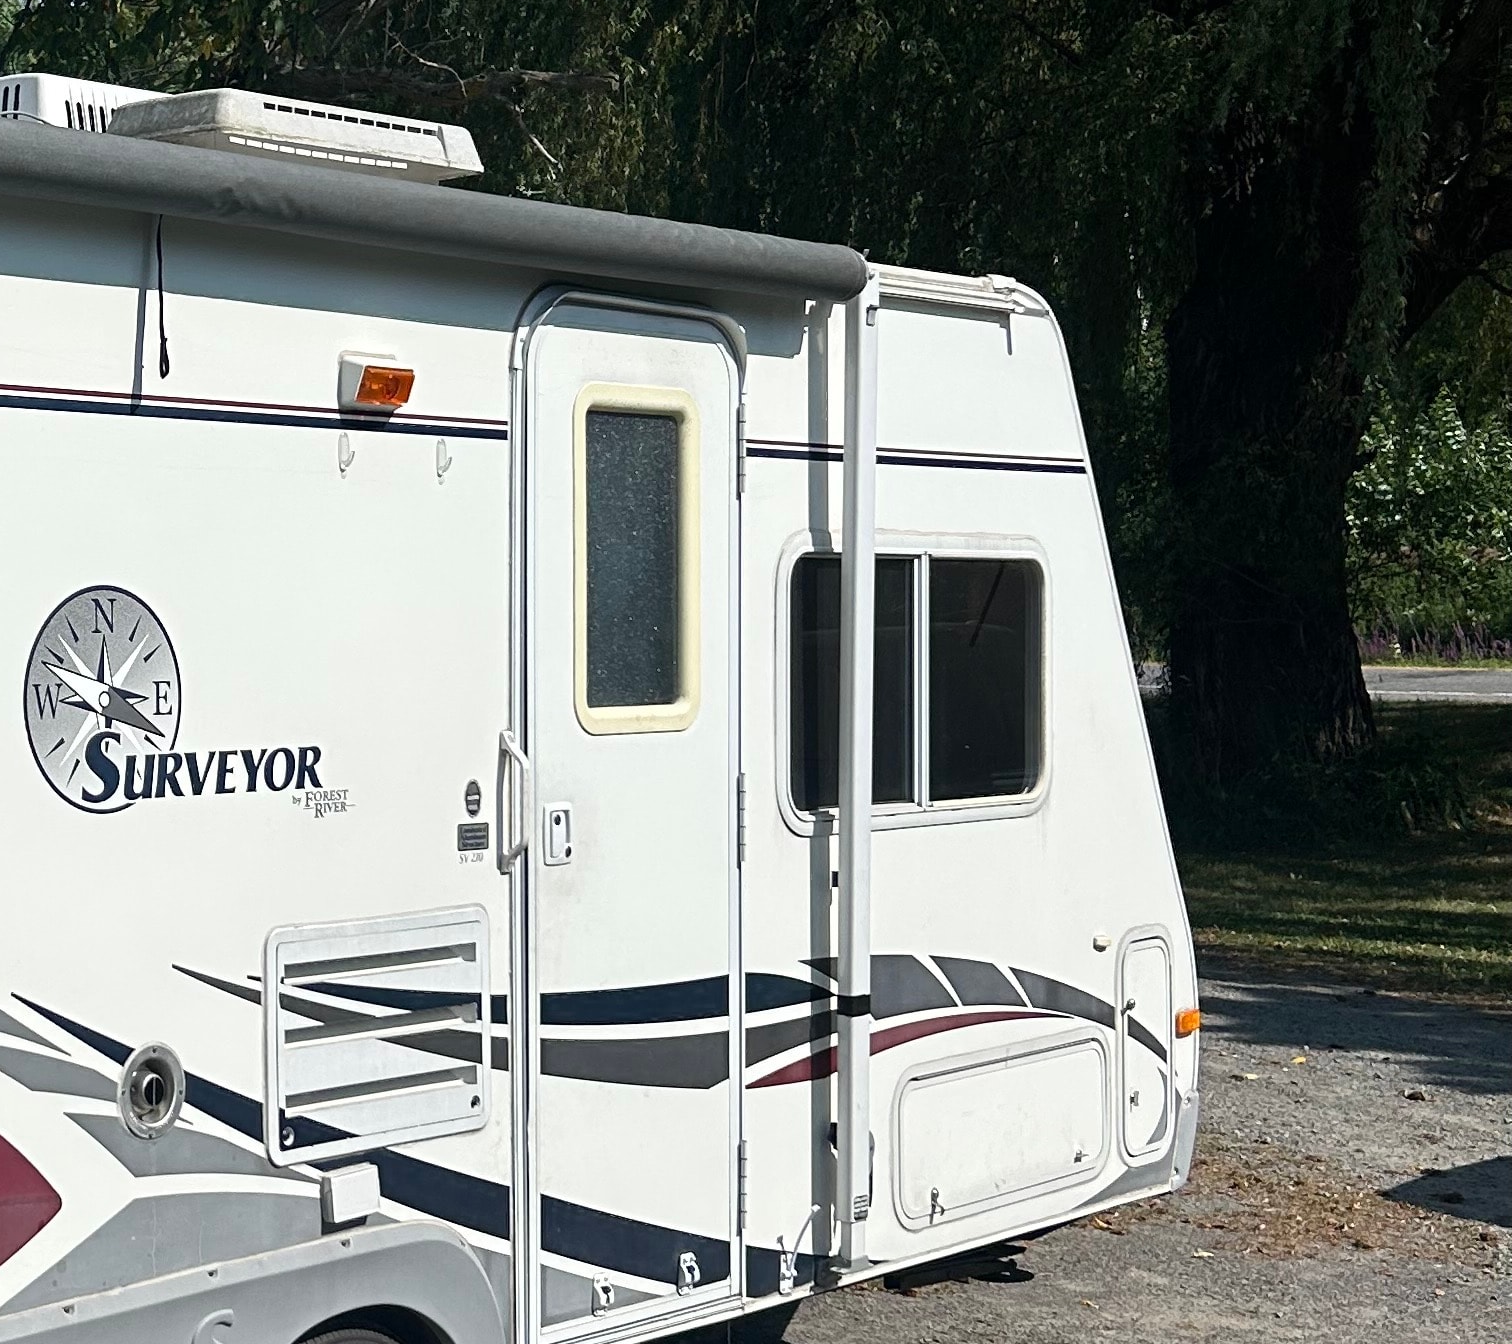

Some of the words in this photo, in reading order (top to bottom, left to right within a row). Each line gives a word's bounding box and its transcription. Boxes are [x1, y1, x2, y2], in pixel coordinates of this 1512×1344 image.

[91, 598, 117, 634] N
[32, 683, 63, 720] W
[152, 681, 173, 716] E
[81, 731, 323, 804] SURVEYOR
[305, 789, 349, 807] FOREST
[314, 801, 348, 818] RIVER
